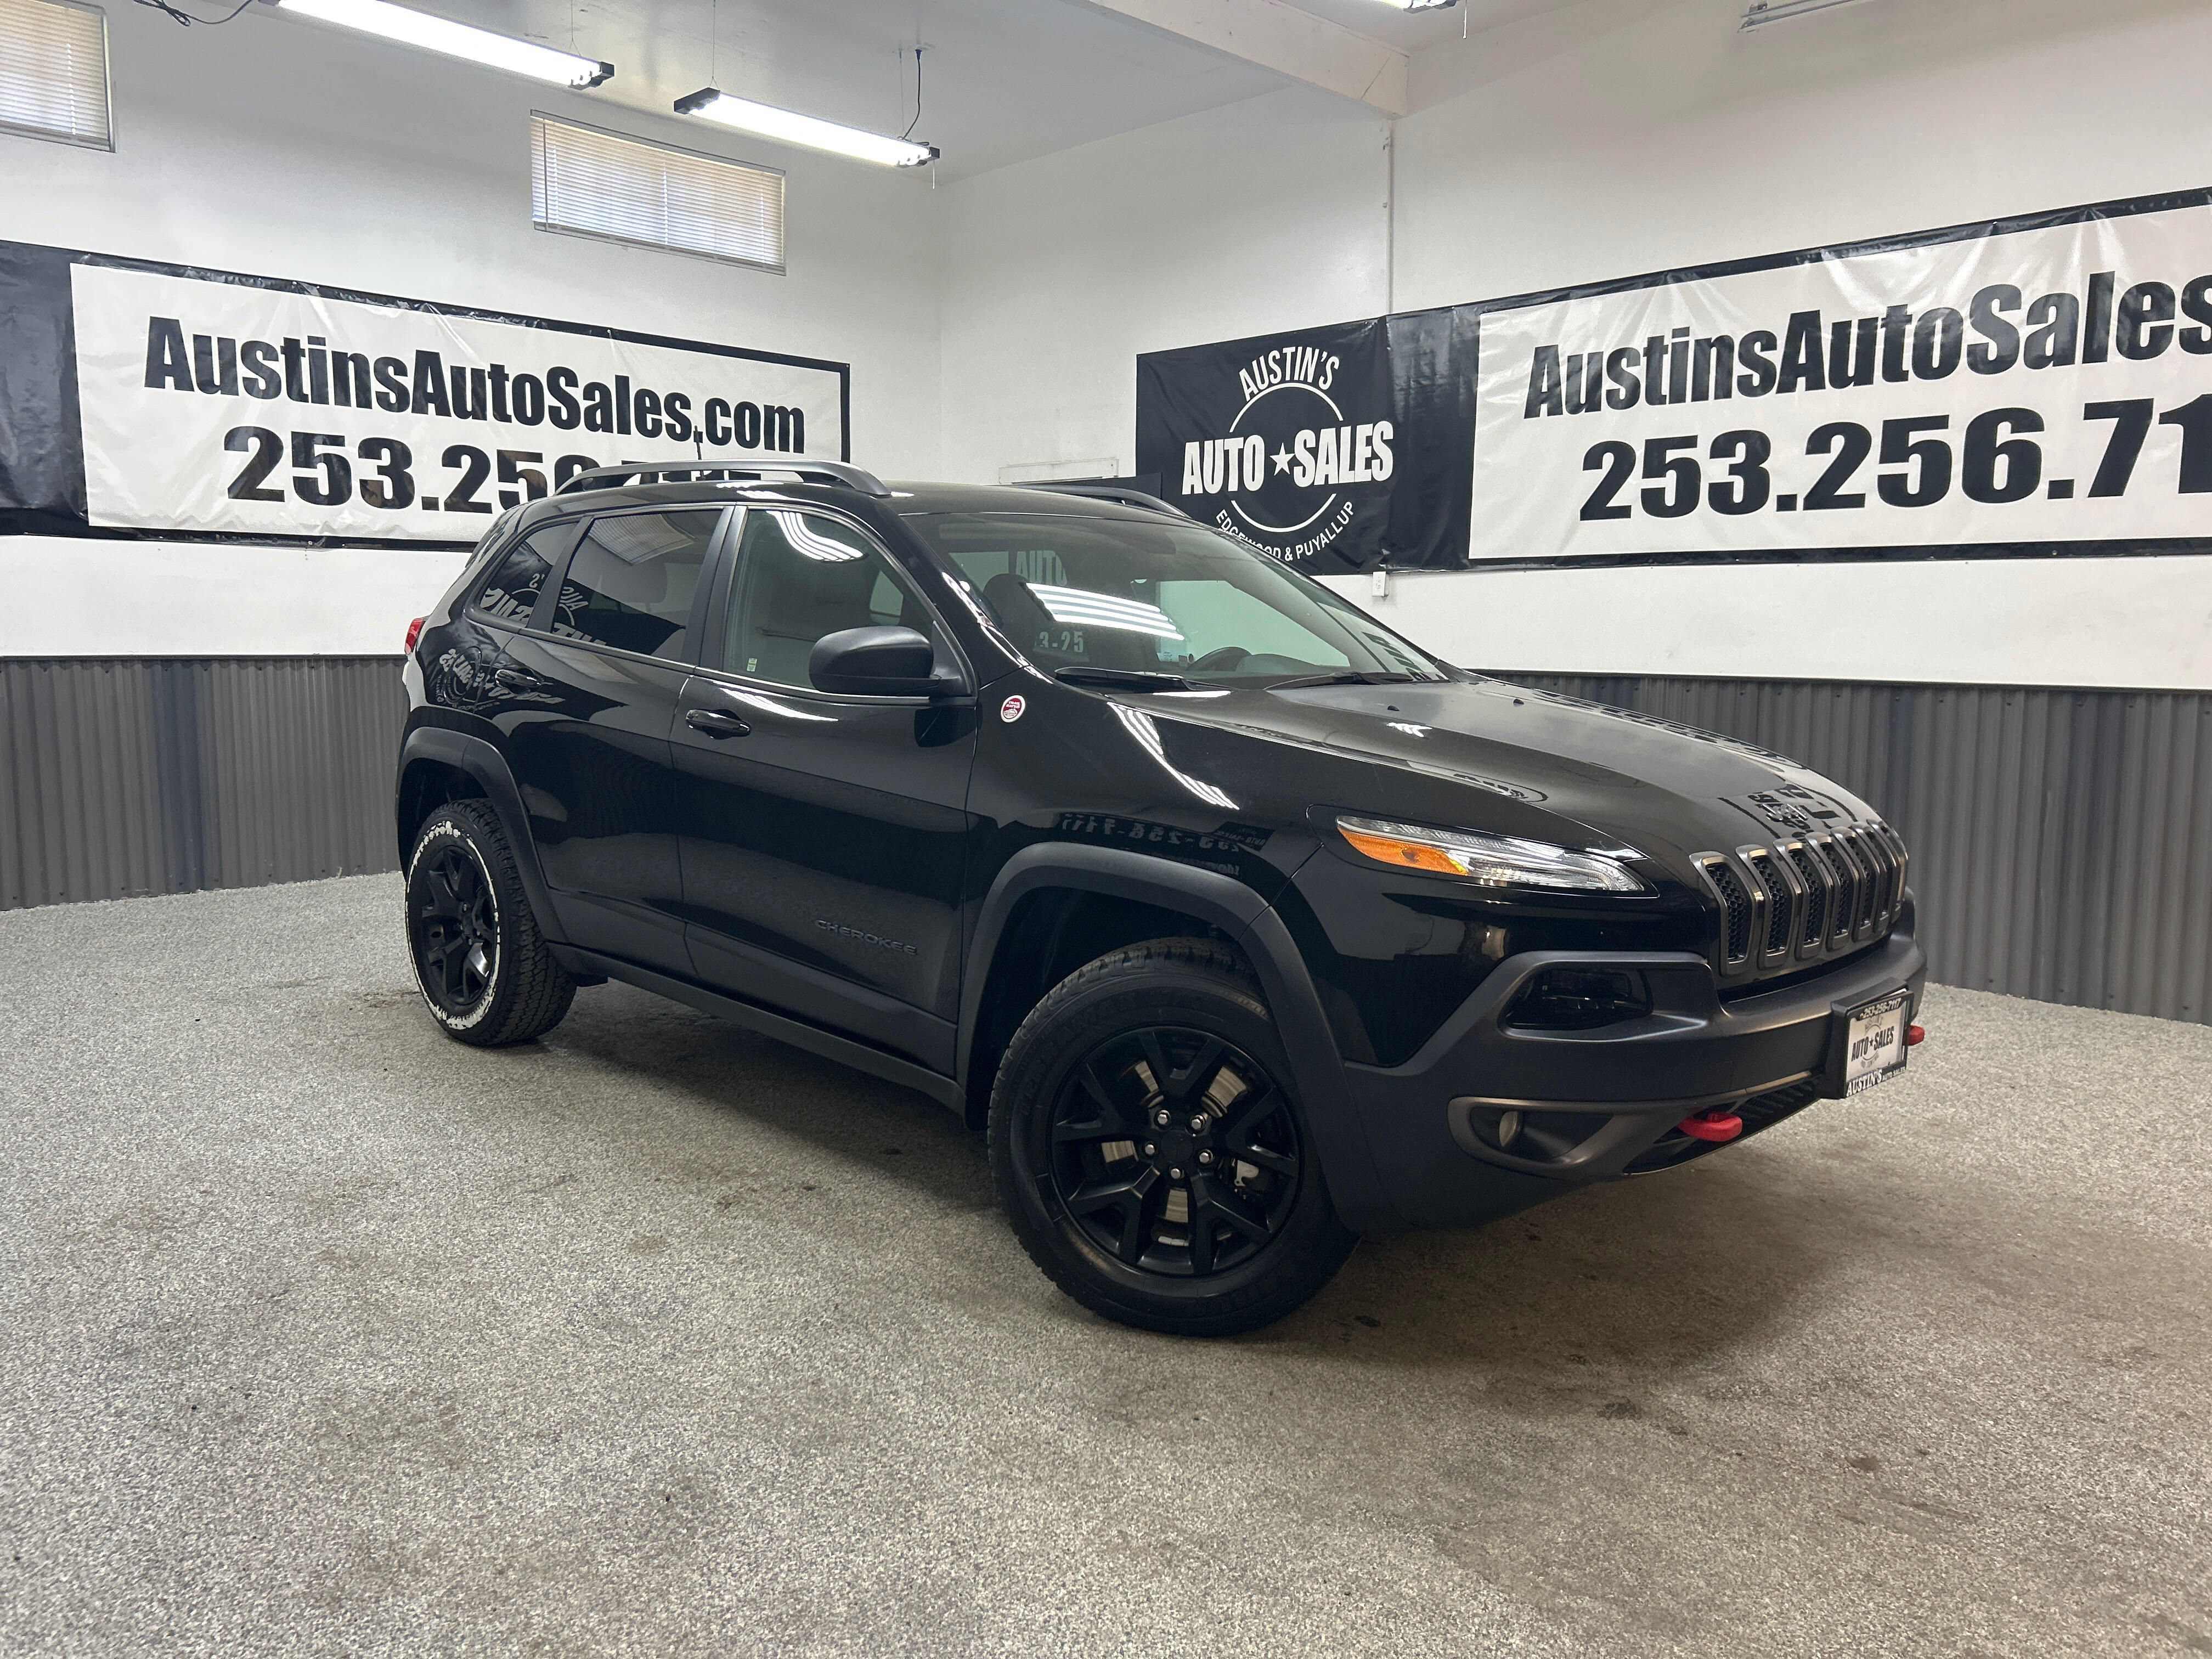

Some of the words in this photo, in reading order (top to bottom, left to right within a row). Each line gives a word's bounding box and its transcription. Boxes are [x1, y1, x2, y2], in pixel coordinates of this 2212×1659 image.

[144, 316, 804, 454] AustinsAutoSales.com
[1239, 346, 1340, 402] AUSTIN'S
[1182, 435, 1265, 495] AUTO
[1294, 420, 1394, 488] SALES
[1284, 547, 1293, 561] &
[1295, 501, 1354, 560] PUYALLUP
[815, 919, 918, 956] CHEROKEE
[1851, 1036, 1869, 1062] AUTO
[1874, 1025, 1894, 1051] SALES
[1846, 1069, 1882, 1097] AUSTIN'S
